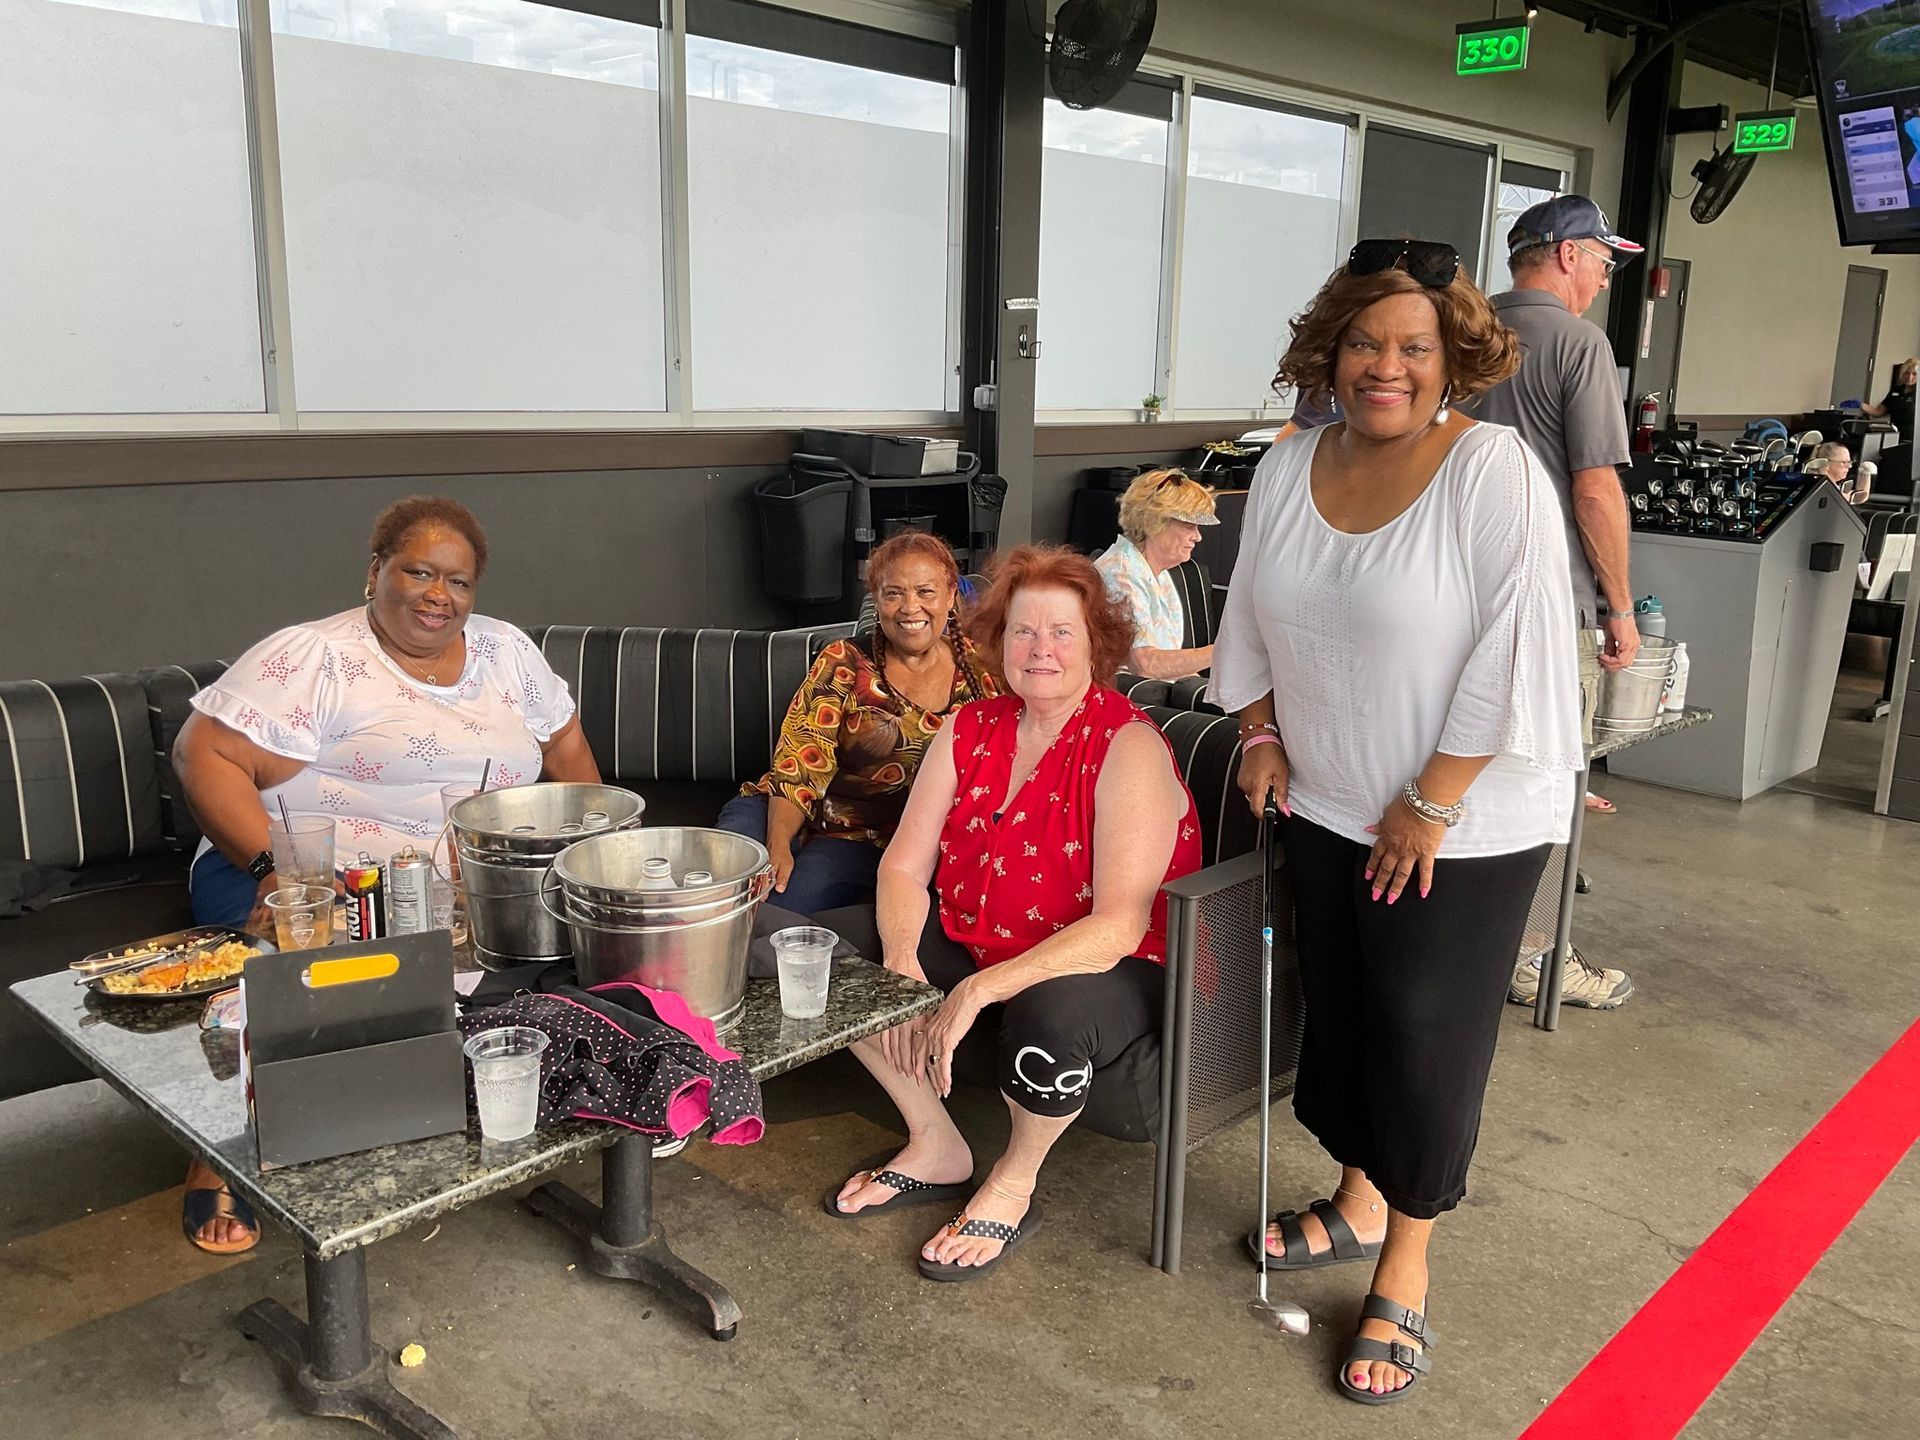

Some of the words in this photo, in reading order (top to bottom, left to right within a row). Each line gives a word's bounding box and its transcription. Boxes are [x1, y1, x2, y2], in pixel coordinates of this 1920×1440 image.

[1463, 35, 1519, 65] 330
[1741, 123, 1787, 145] 329
[1878, 197, 1898, 207] 331
[1014, 1045, 1092, 1094] Ca
